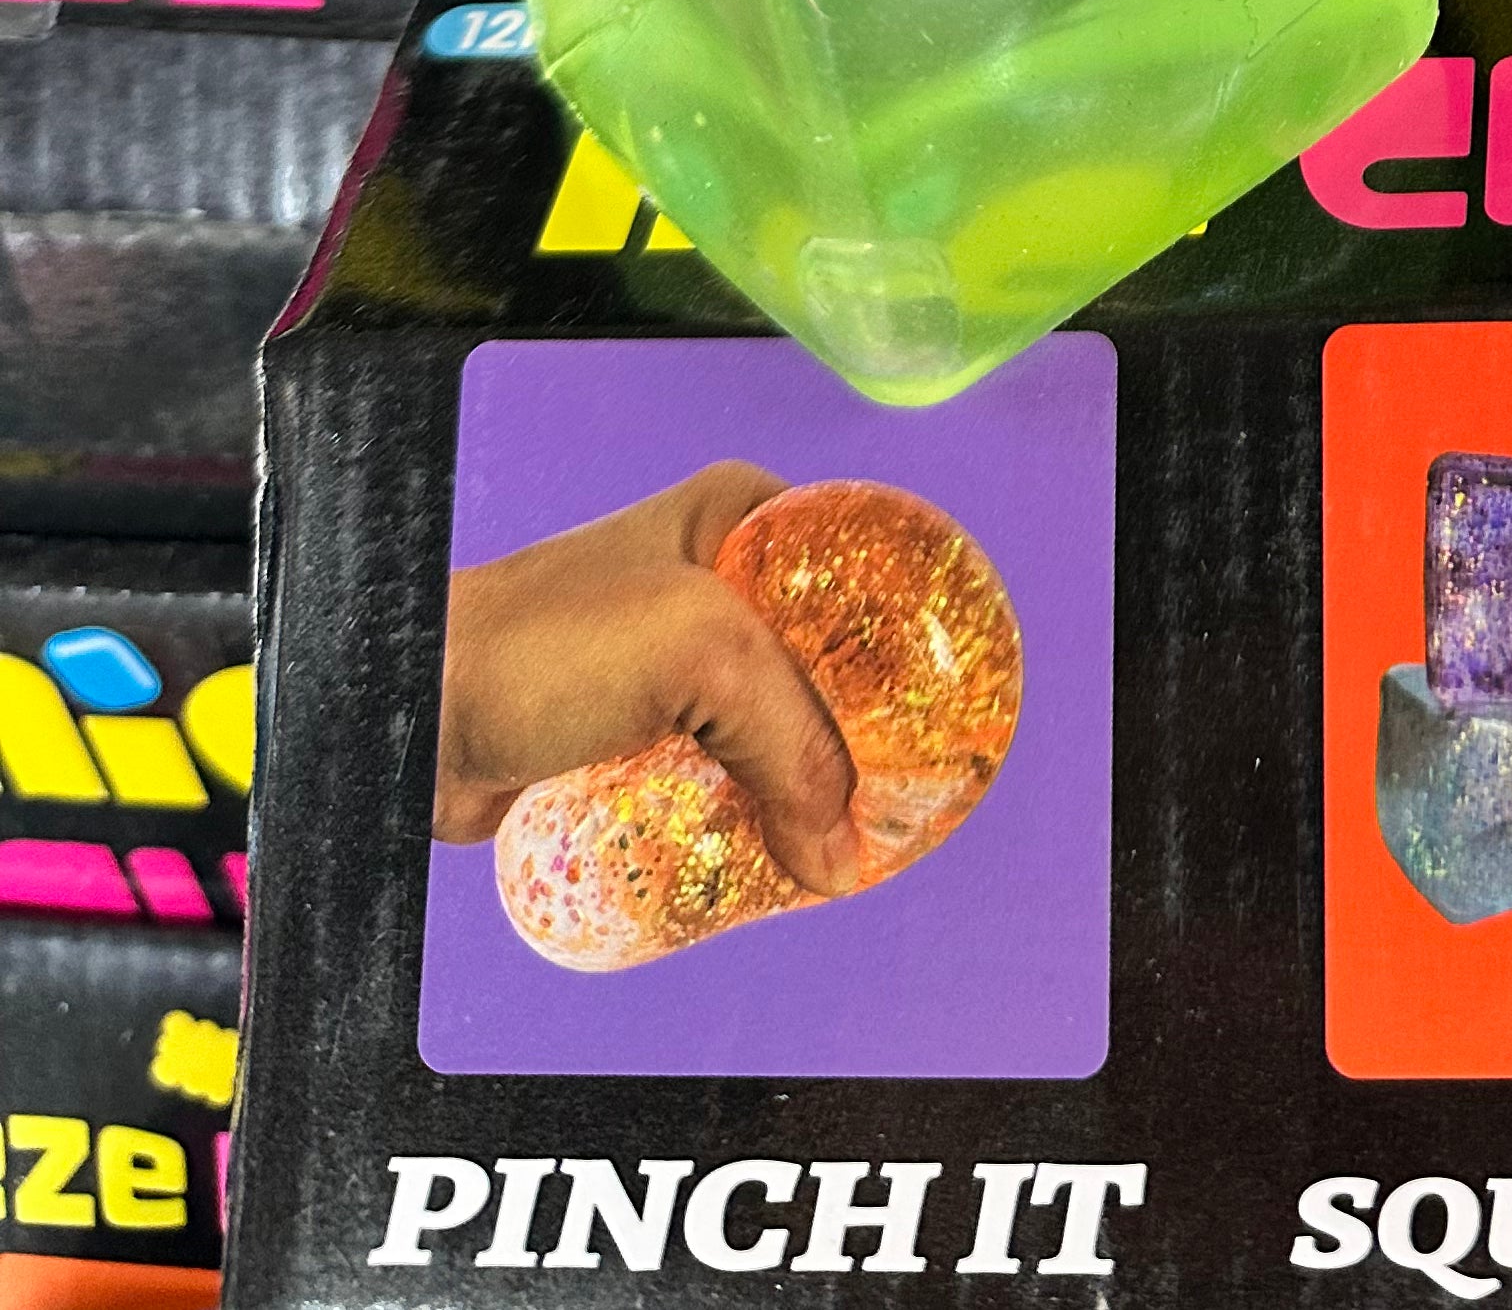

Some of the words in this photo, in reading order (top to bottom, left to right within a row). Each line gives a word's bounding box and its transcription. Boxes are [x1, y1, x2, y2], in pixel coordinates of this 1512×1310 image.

[0, 1113, 188, 1229] ze
[366, 1156, 943, 1273] PINCH
[955, 1162, 1147, 1276] IT
